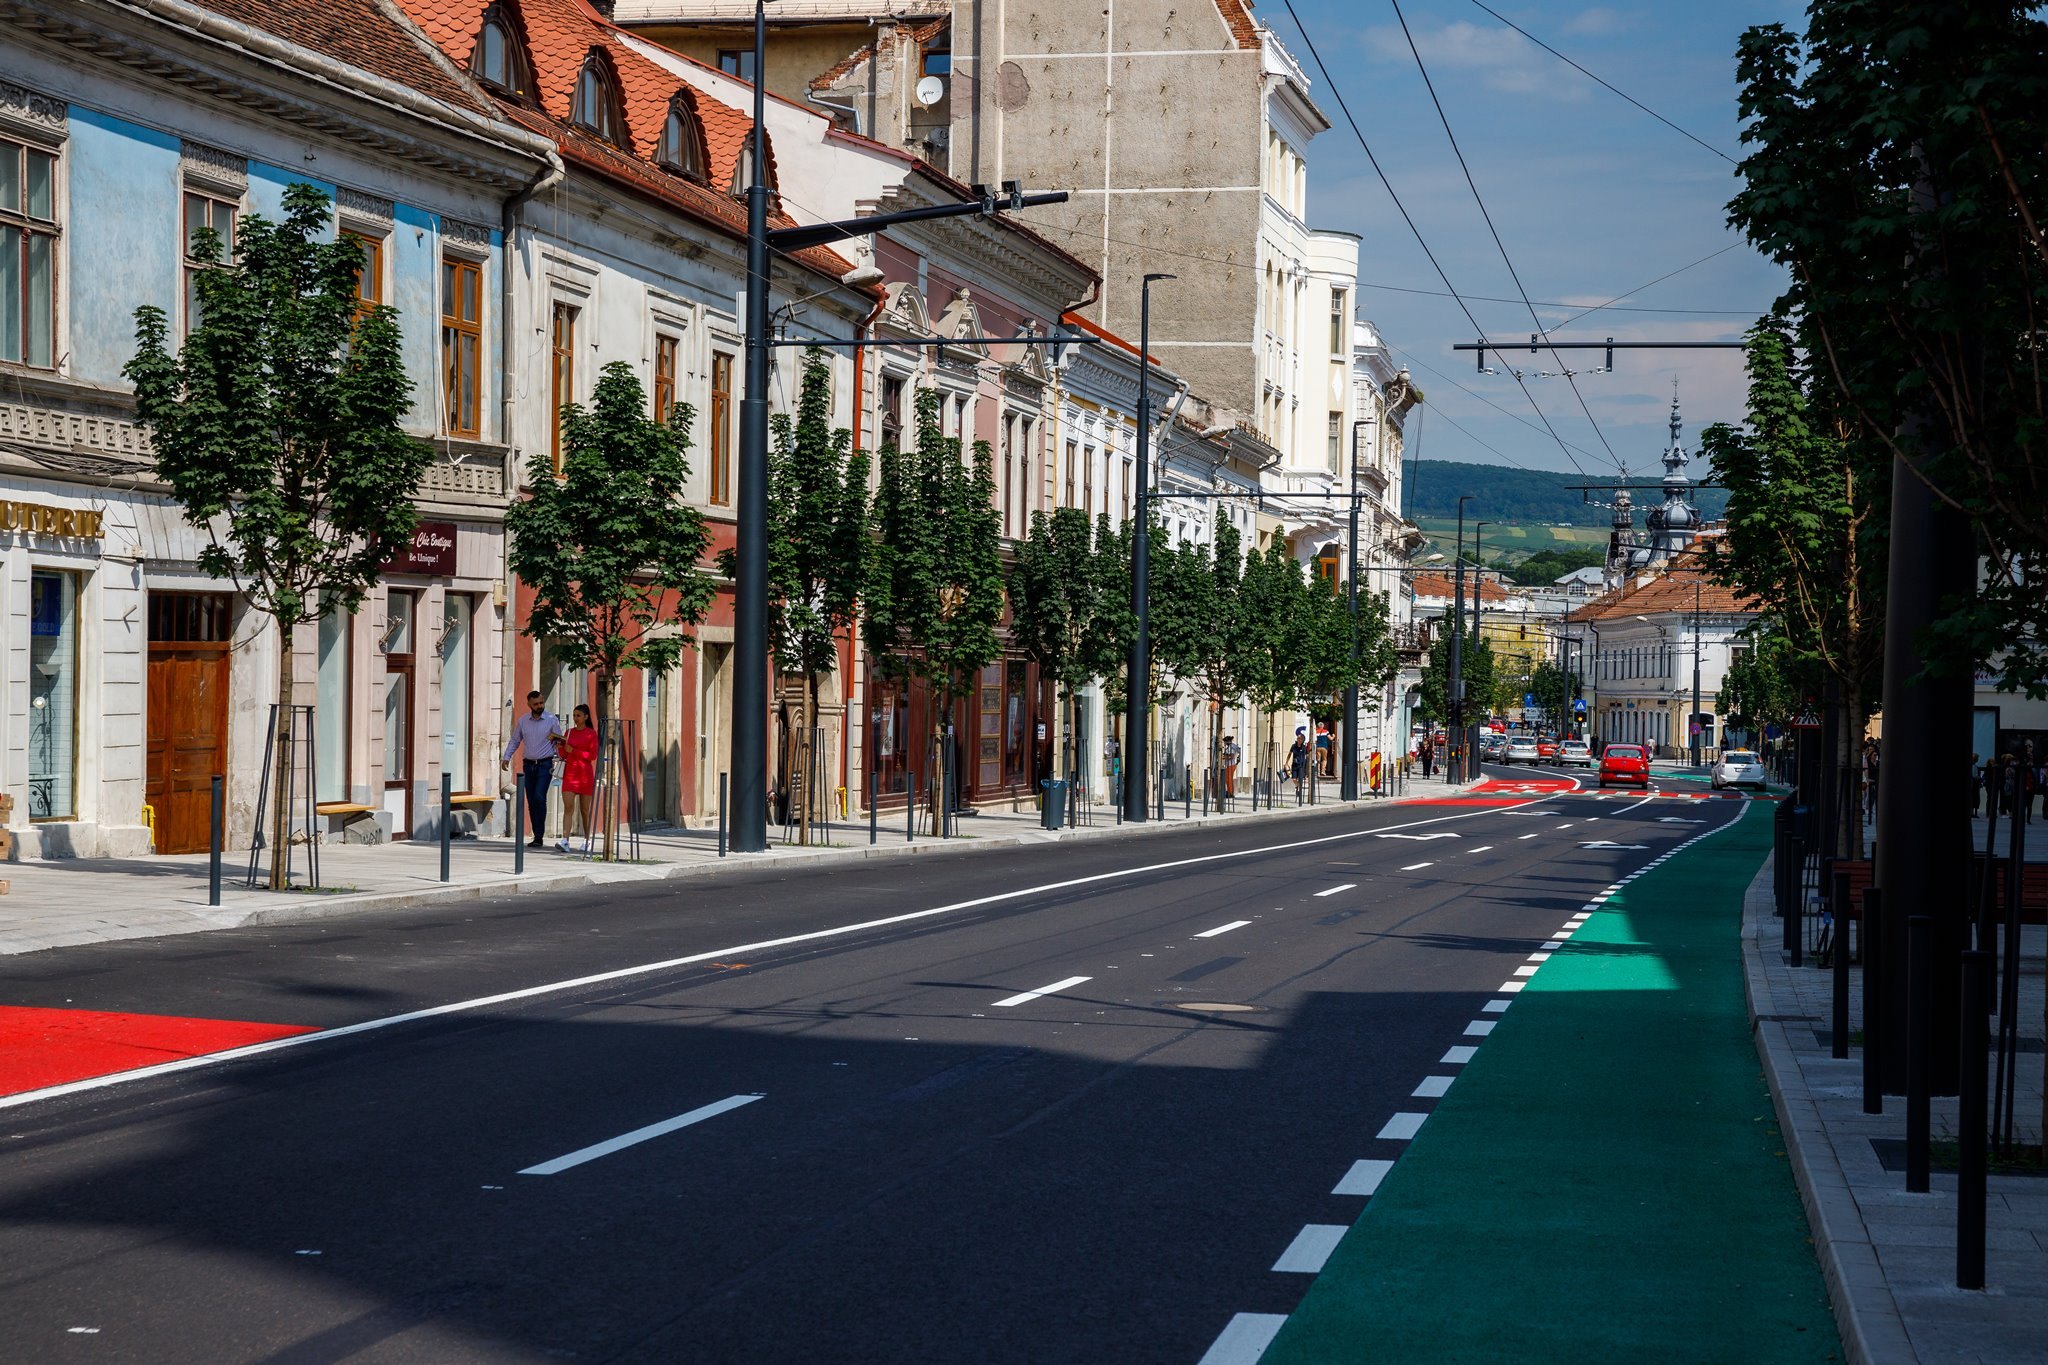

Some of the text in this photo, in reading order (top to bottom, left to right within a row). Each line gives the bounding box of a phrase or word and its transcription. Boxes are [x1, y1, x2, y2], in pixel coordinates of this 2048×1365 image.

[416, 532, 430, 548] Chic
[430, 533, 452, 551] Boutique
[409, 553, 416, 562] Be
